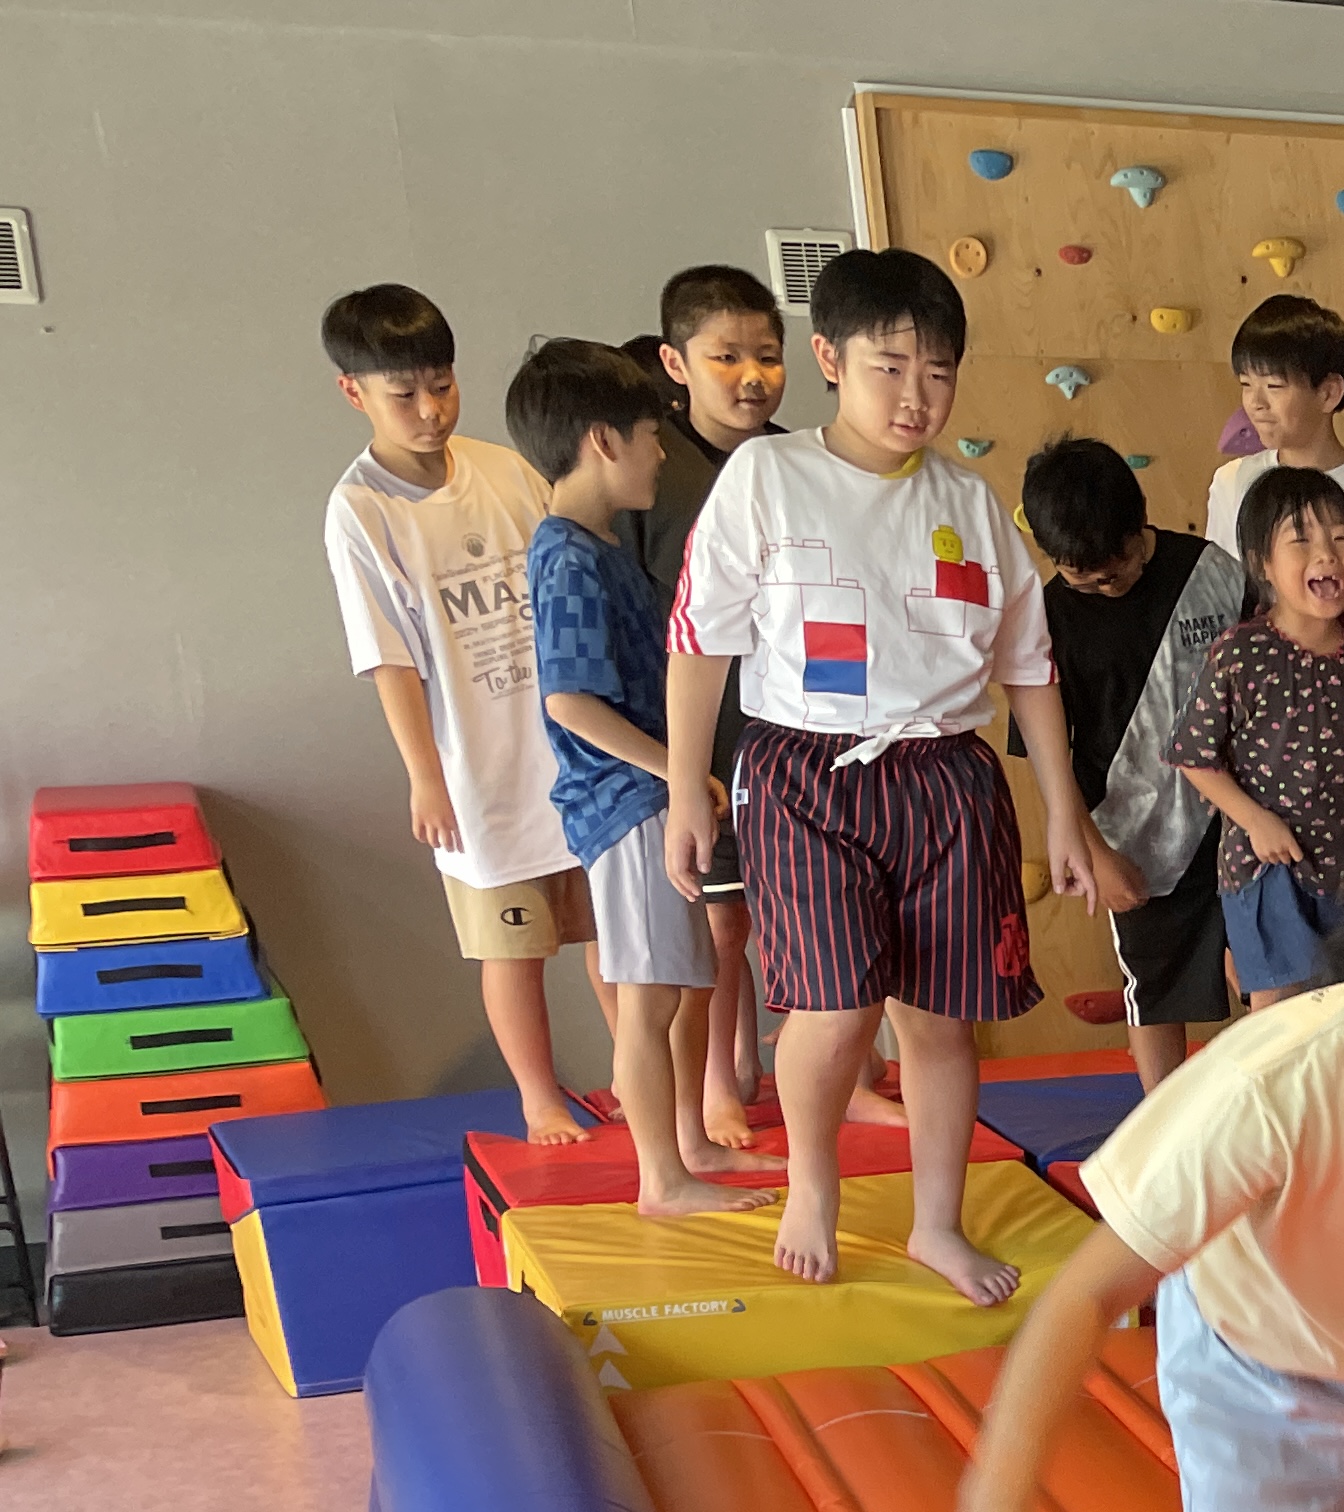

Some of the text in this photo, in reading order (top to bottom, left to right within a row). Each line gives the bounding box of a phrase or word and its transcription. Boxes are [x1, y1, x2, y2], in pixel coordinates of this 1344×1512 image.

[1178, 614, 1216, 632] MAKE
[1180, 629, 1219, 647] HAPP
[602, 1300, 728, 1322] MUSCLE FACTORY
